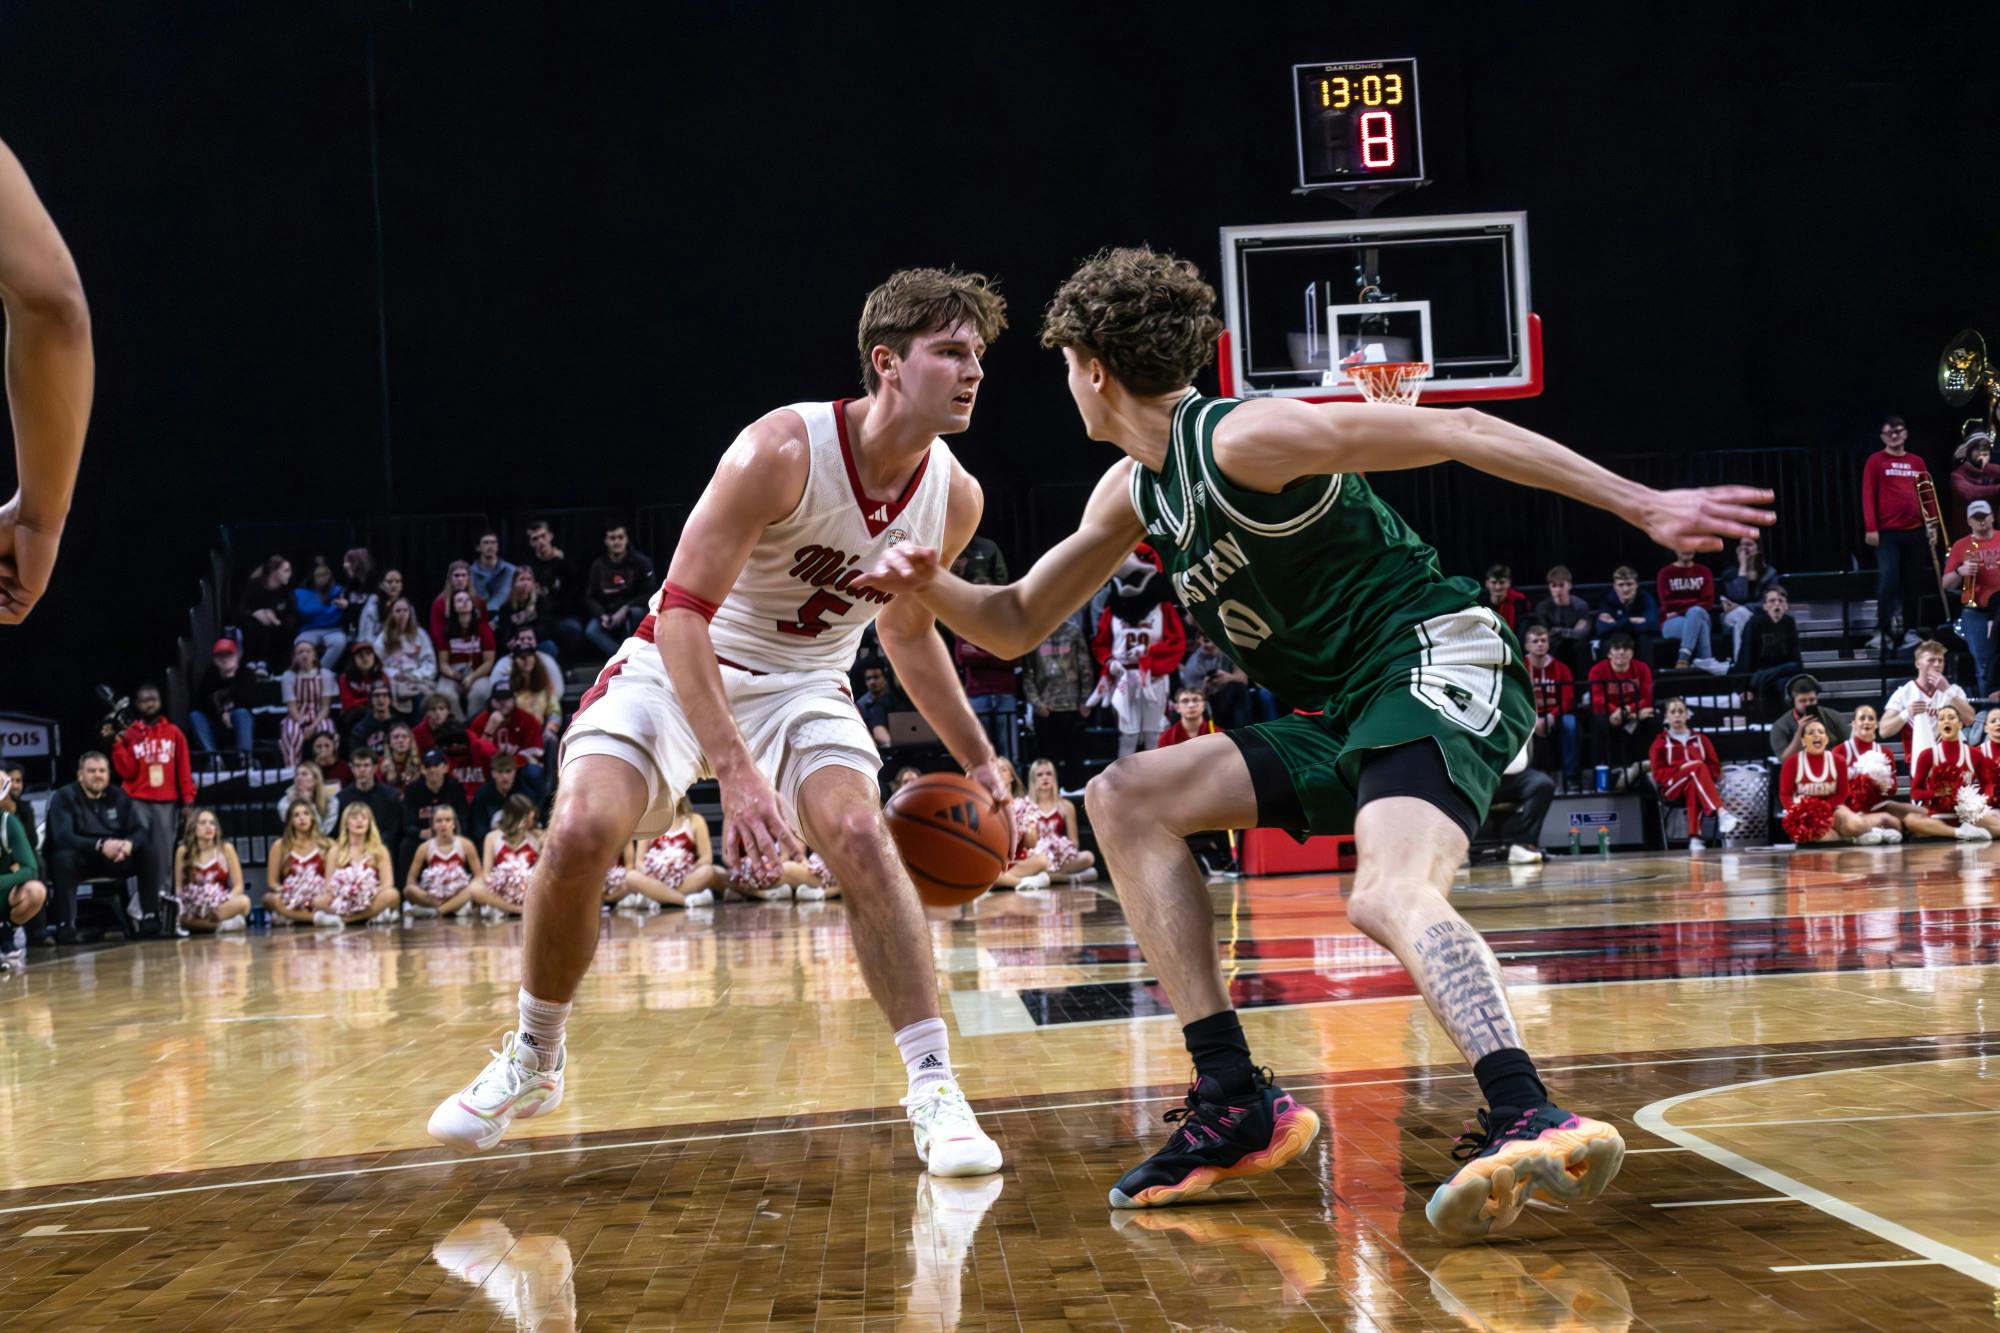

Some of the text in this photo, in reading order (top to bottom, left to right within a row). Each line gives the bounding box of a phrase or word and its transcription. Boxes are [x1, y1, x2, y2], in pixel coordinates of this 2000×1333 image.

[1325, 62, 1384, 72] DAKTRONICS
[1321, 74, 1403, 108] 13:03
[1360, 111, 1395, 168] 8
